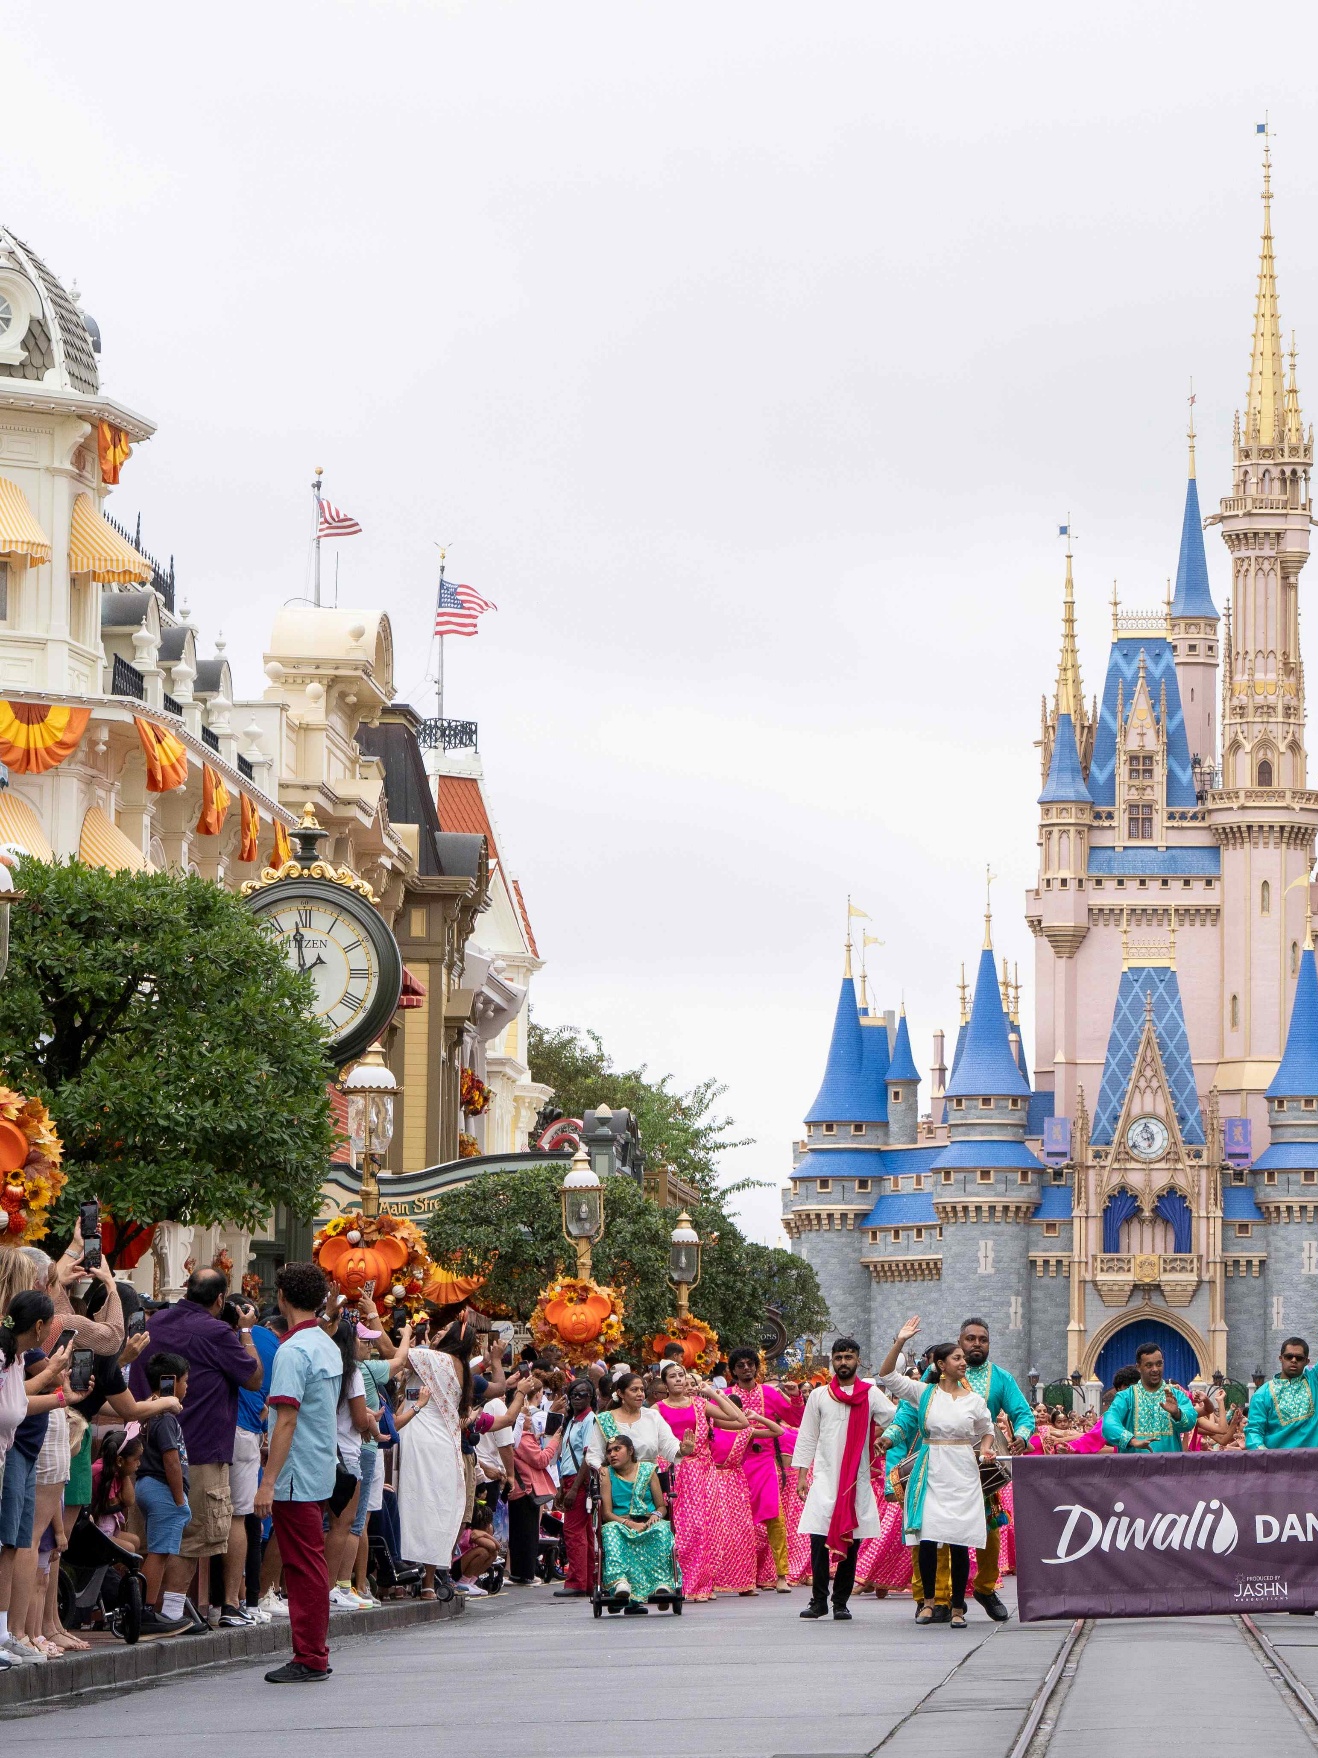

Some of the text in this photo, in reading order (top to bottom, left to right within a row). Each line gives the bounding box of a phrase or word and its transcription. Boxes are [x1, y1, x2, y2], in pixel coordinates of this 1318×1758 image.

[379, 1198, 441, 1216] Main Stre
[1041, 1499, 1221, 1564] Diwali
[1233, 1582, 1289, 1598] JASHN
